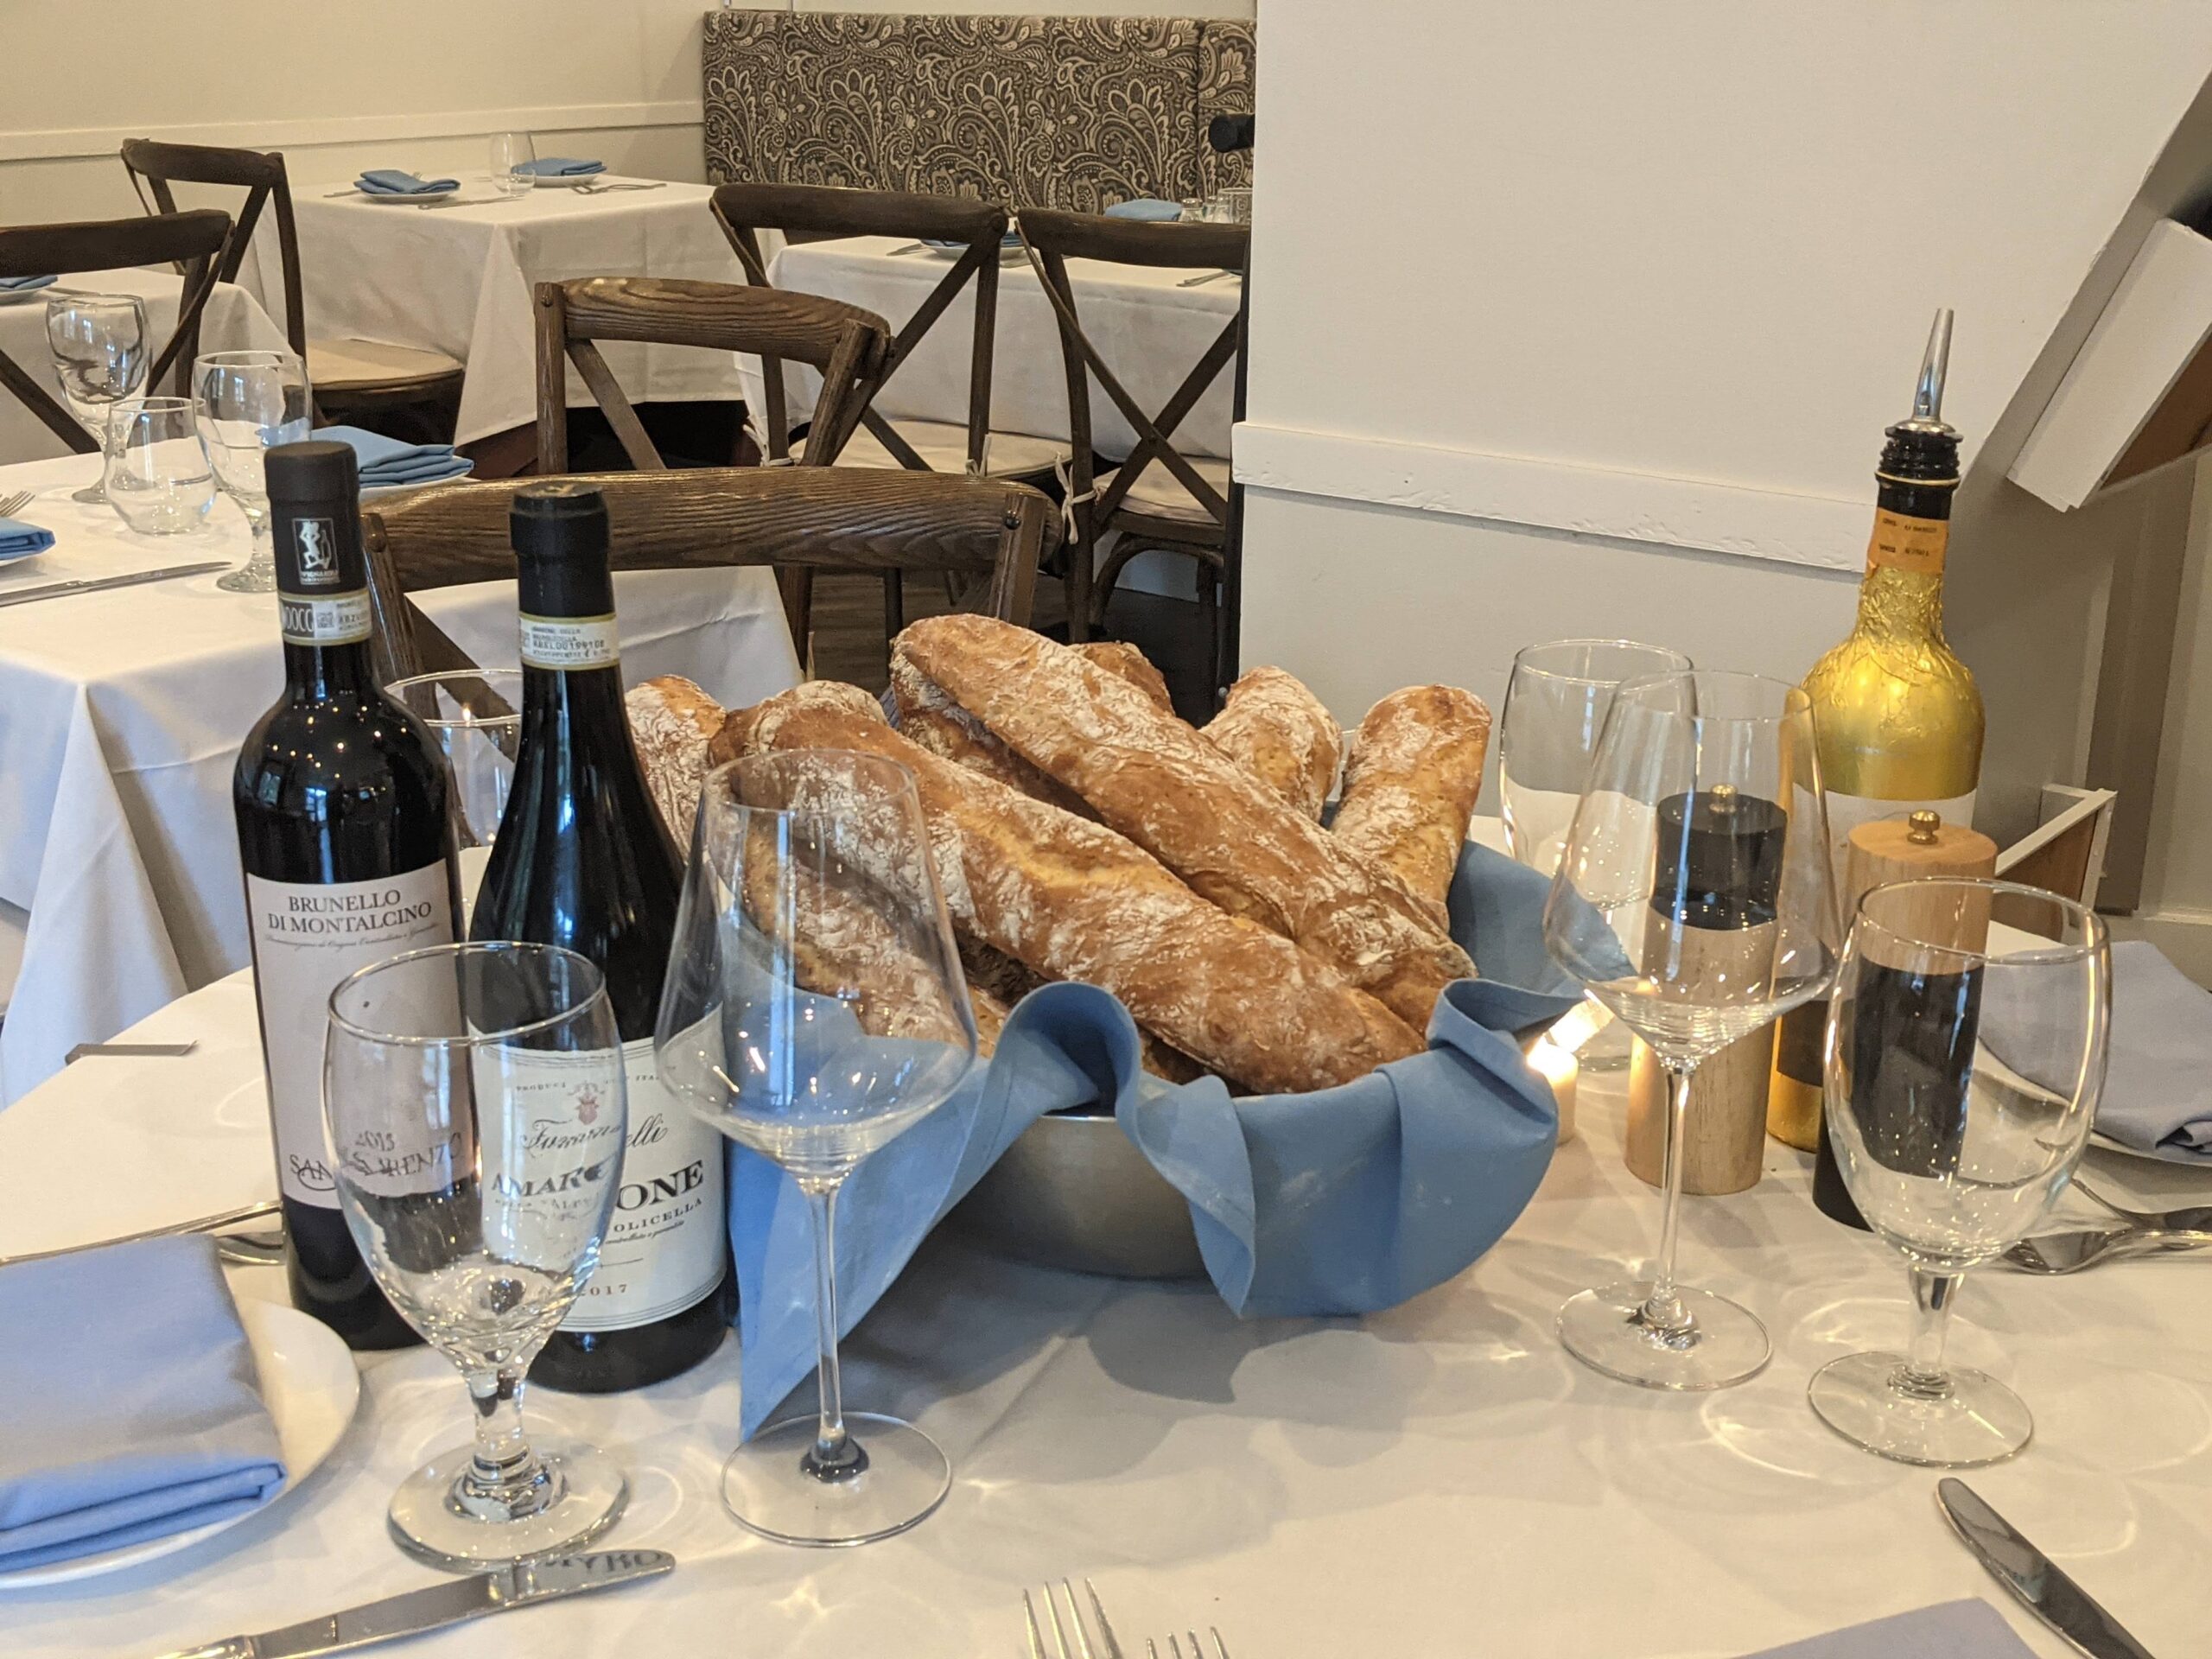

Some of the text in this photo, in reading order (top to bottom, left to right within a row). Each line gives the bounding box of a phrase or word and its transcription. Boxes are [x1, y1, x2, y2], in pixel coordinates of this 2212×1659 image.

[289, 889, 400, 912] BRUNELLO
[268, 901, 432, 934] DI MONTALCINO
[580, 1284, 627, 1296] 017
